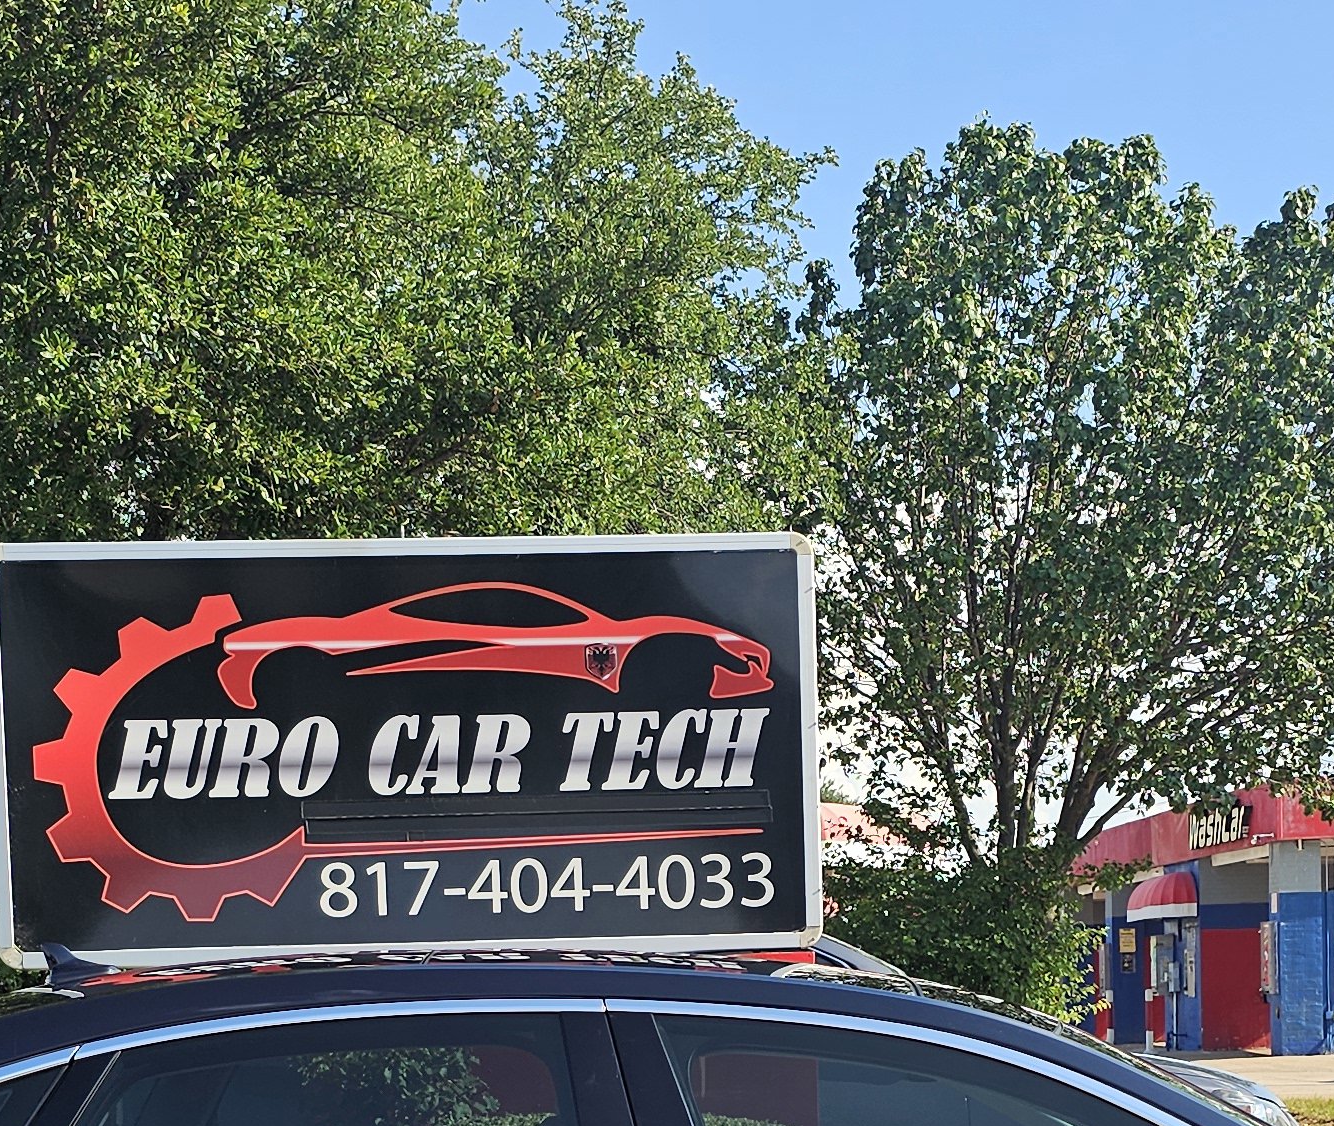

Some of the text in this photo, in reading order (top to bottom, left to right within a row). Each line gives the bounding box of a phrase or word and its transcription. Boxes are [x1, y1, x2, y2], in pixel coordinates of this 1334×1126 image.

[108, 708, 770, 799] EURO CAR TECH
[319, 852, 775, 919] 817-404-4033
